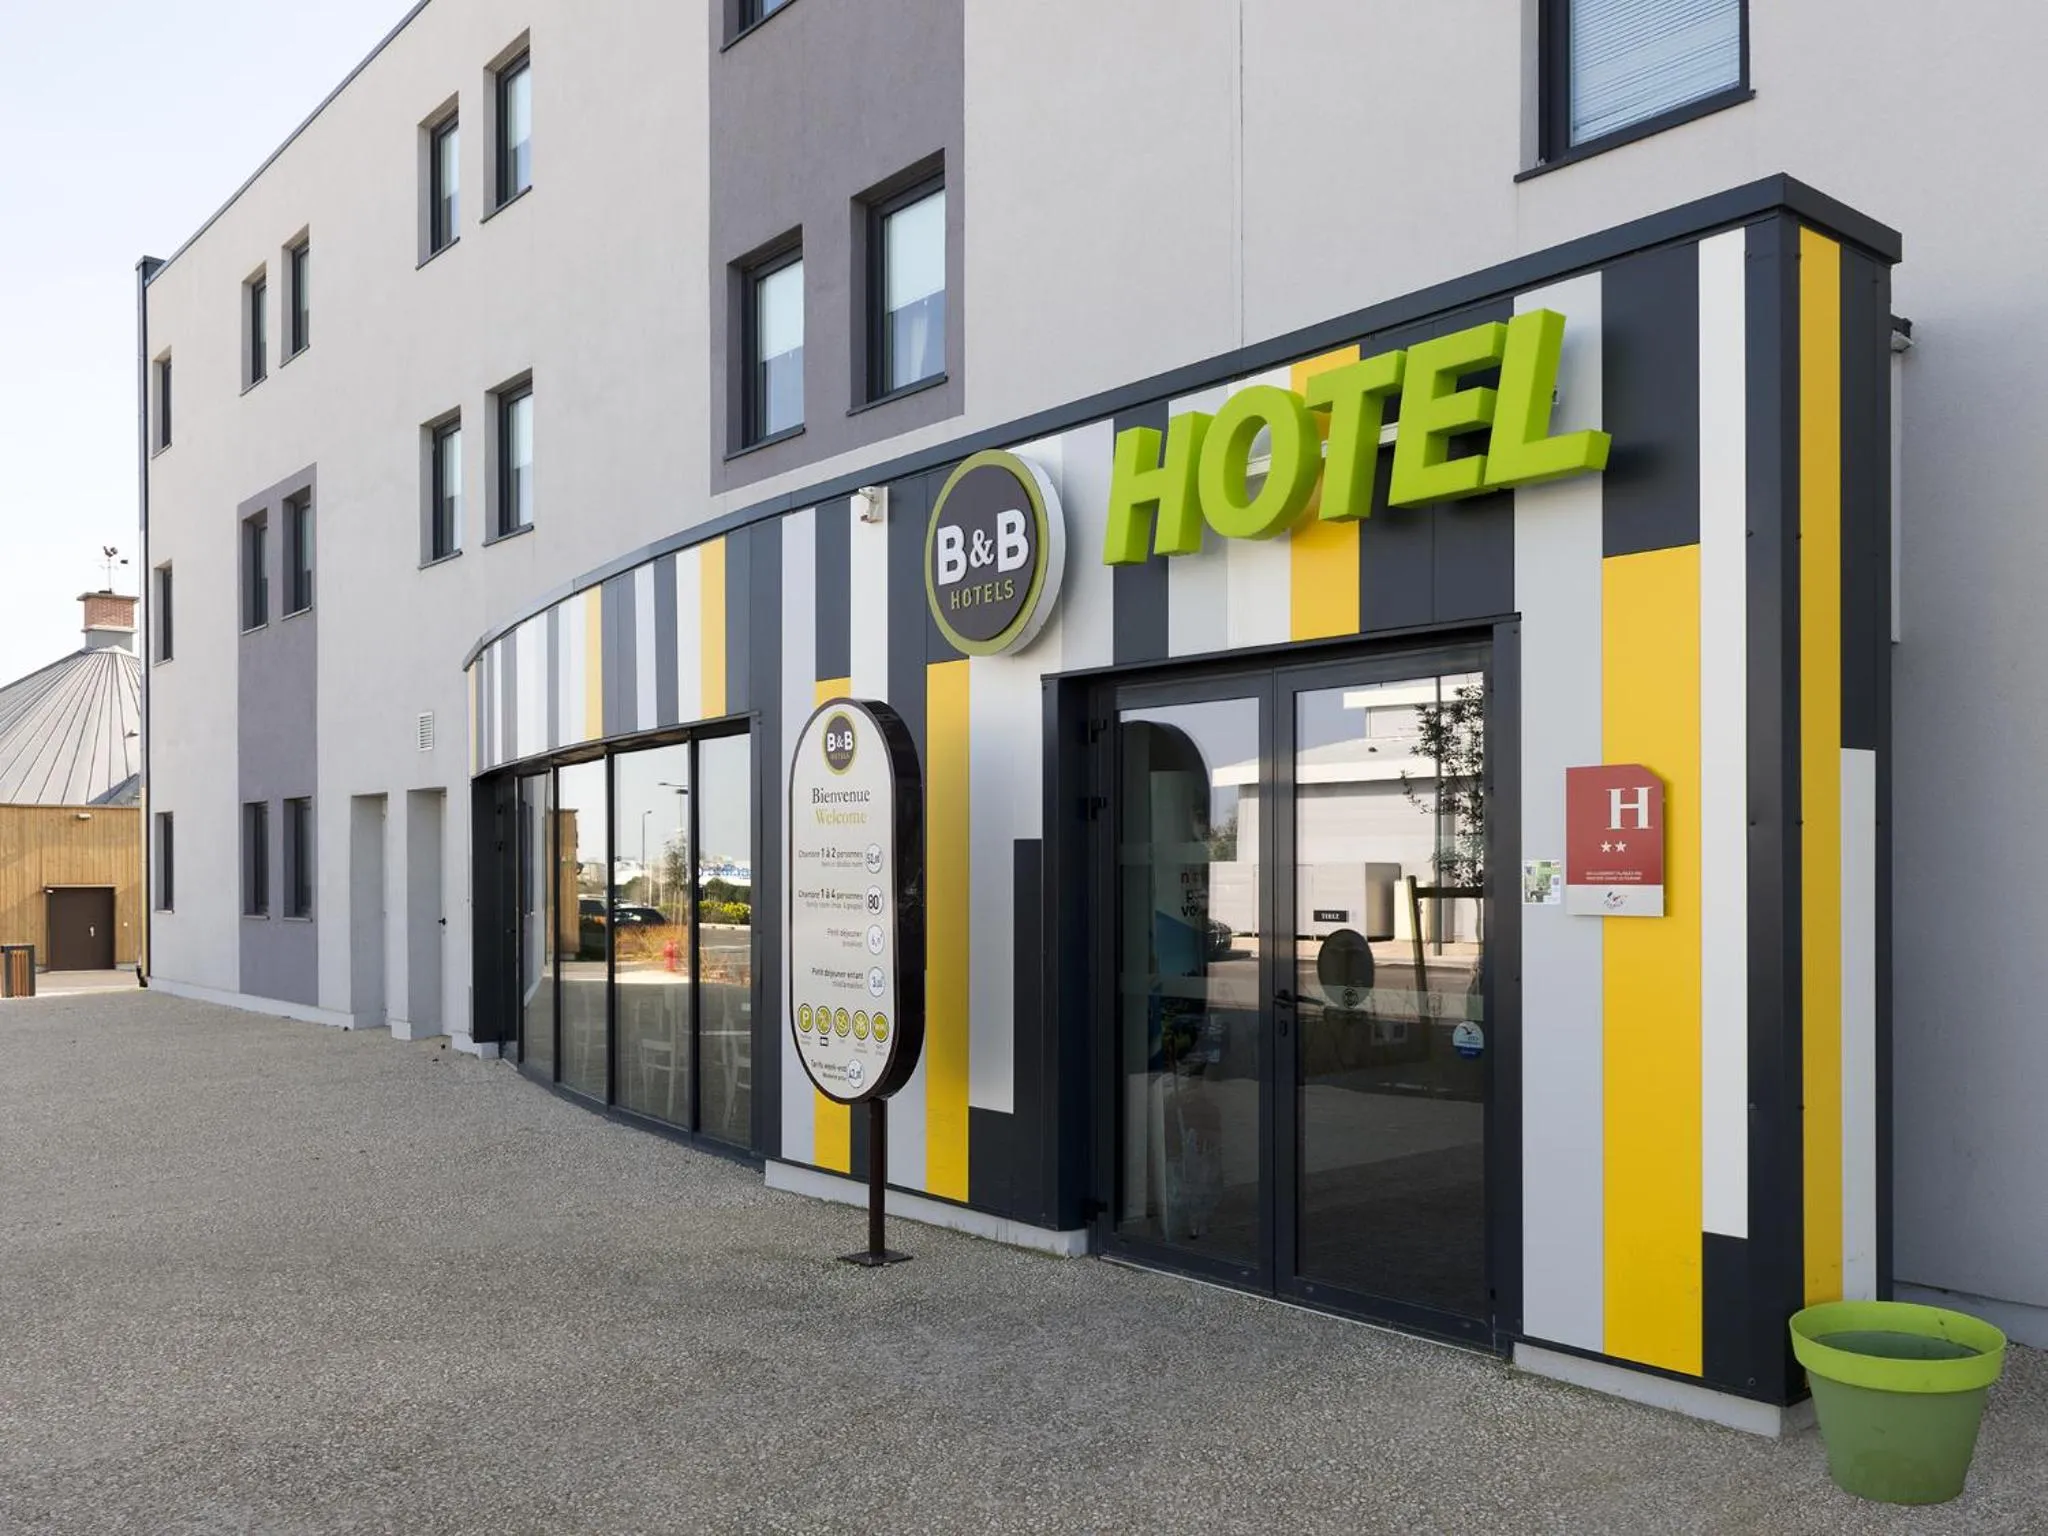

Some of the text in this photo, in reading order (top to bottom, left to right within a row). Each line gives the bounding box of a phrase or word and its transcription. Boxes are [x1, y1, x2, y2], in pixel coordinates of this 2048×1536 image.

[1103, 308, 1611, 566] HOTEL
[938, 509, 1029, 585] B&B
[951, 579, 1014, 610] HOTELS
[826, 732, 853, 752] B&B
[811, 786, 871, 804] Bienvenue
[1605, 786, 1653, 830] H
[816, 807, 867, 825] Welcome
